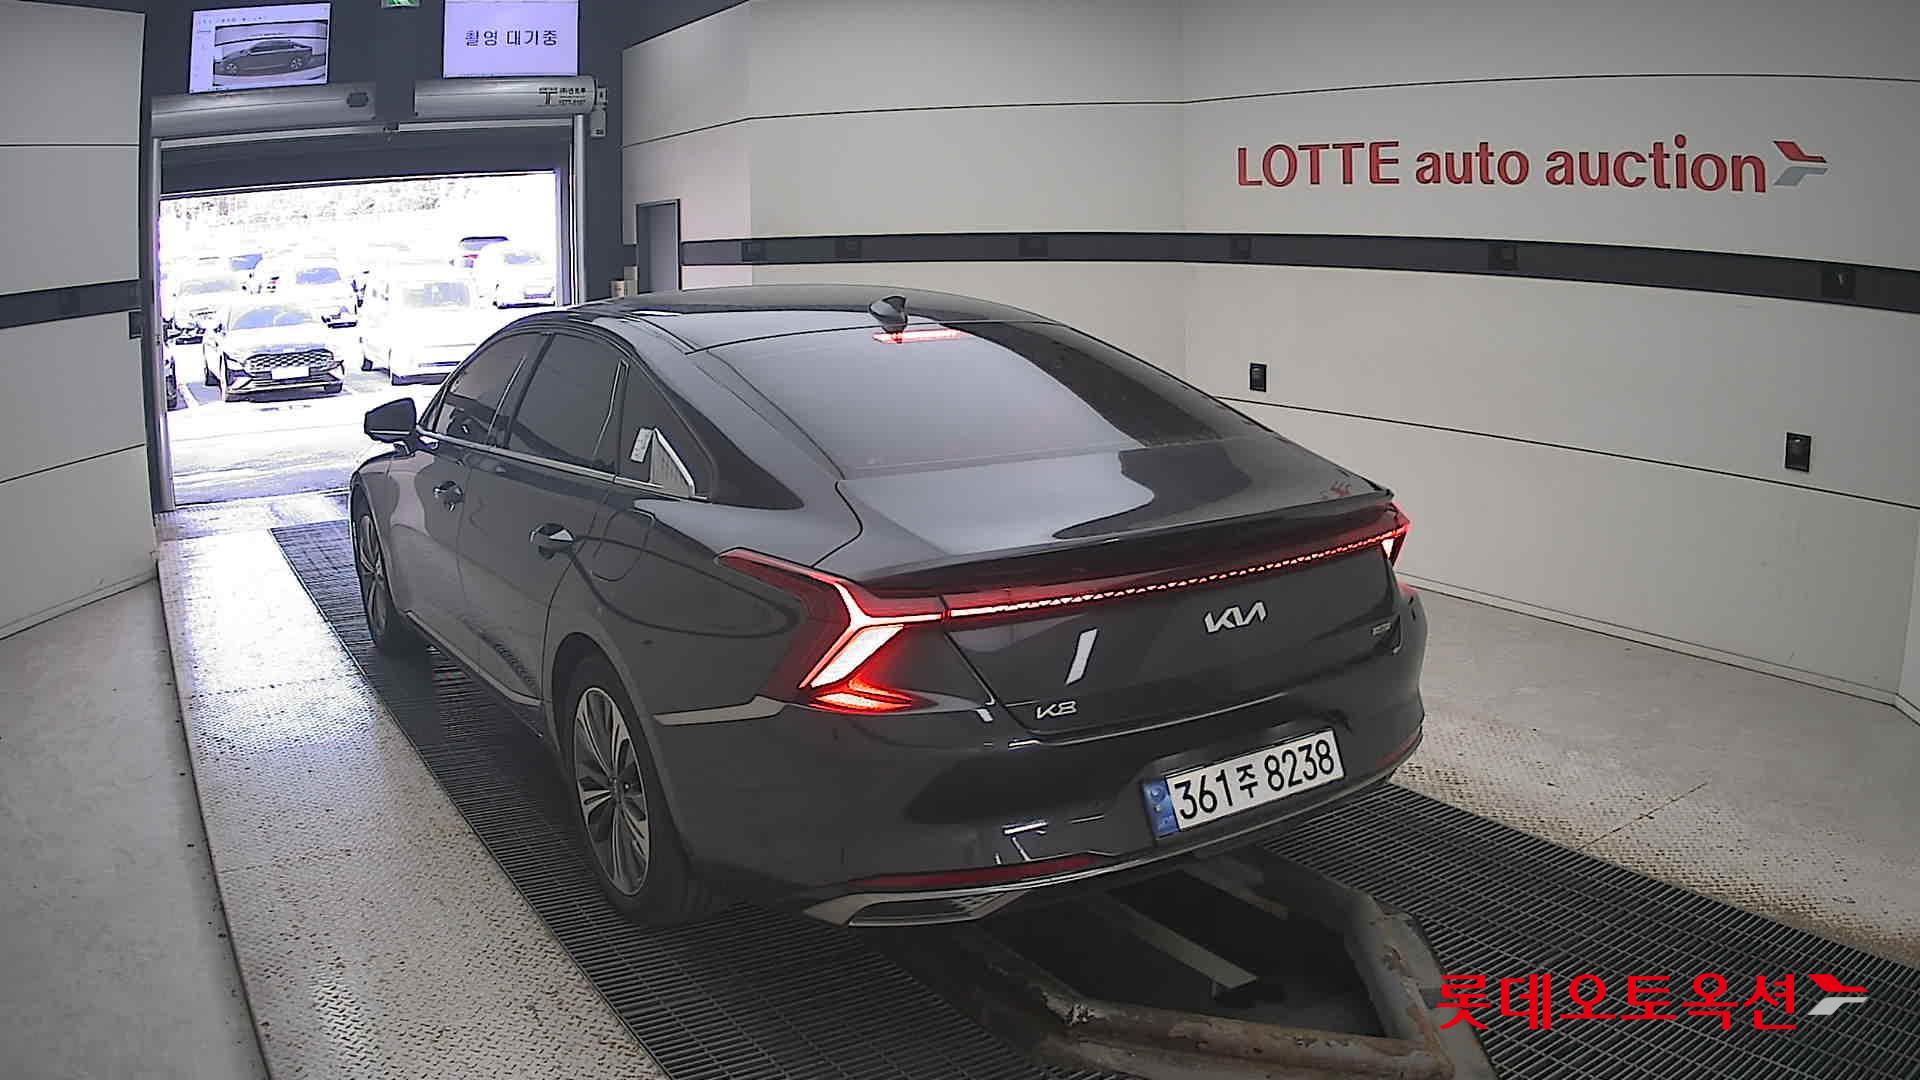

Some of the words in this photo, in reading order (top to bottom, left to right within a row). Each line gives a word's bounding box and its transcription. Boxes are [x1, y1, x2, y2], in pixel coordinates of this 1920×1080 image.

[506, 30, 558, 46] 대기중
[1237, 141, 1400, 188] LOTTE
[1415, 142, 1529, 186] auto
[1545, 134, 1767, 193] auction
[1036, 700, 1078, 719] K8
[1264, 739, 1335, 792] 8238
